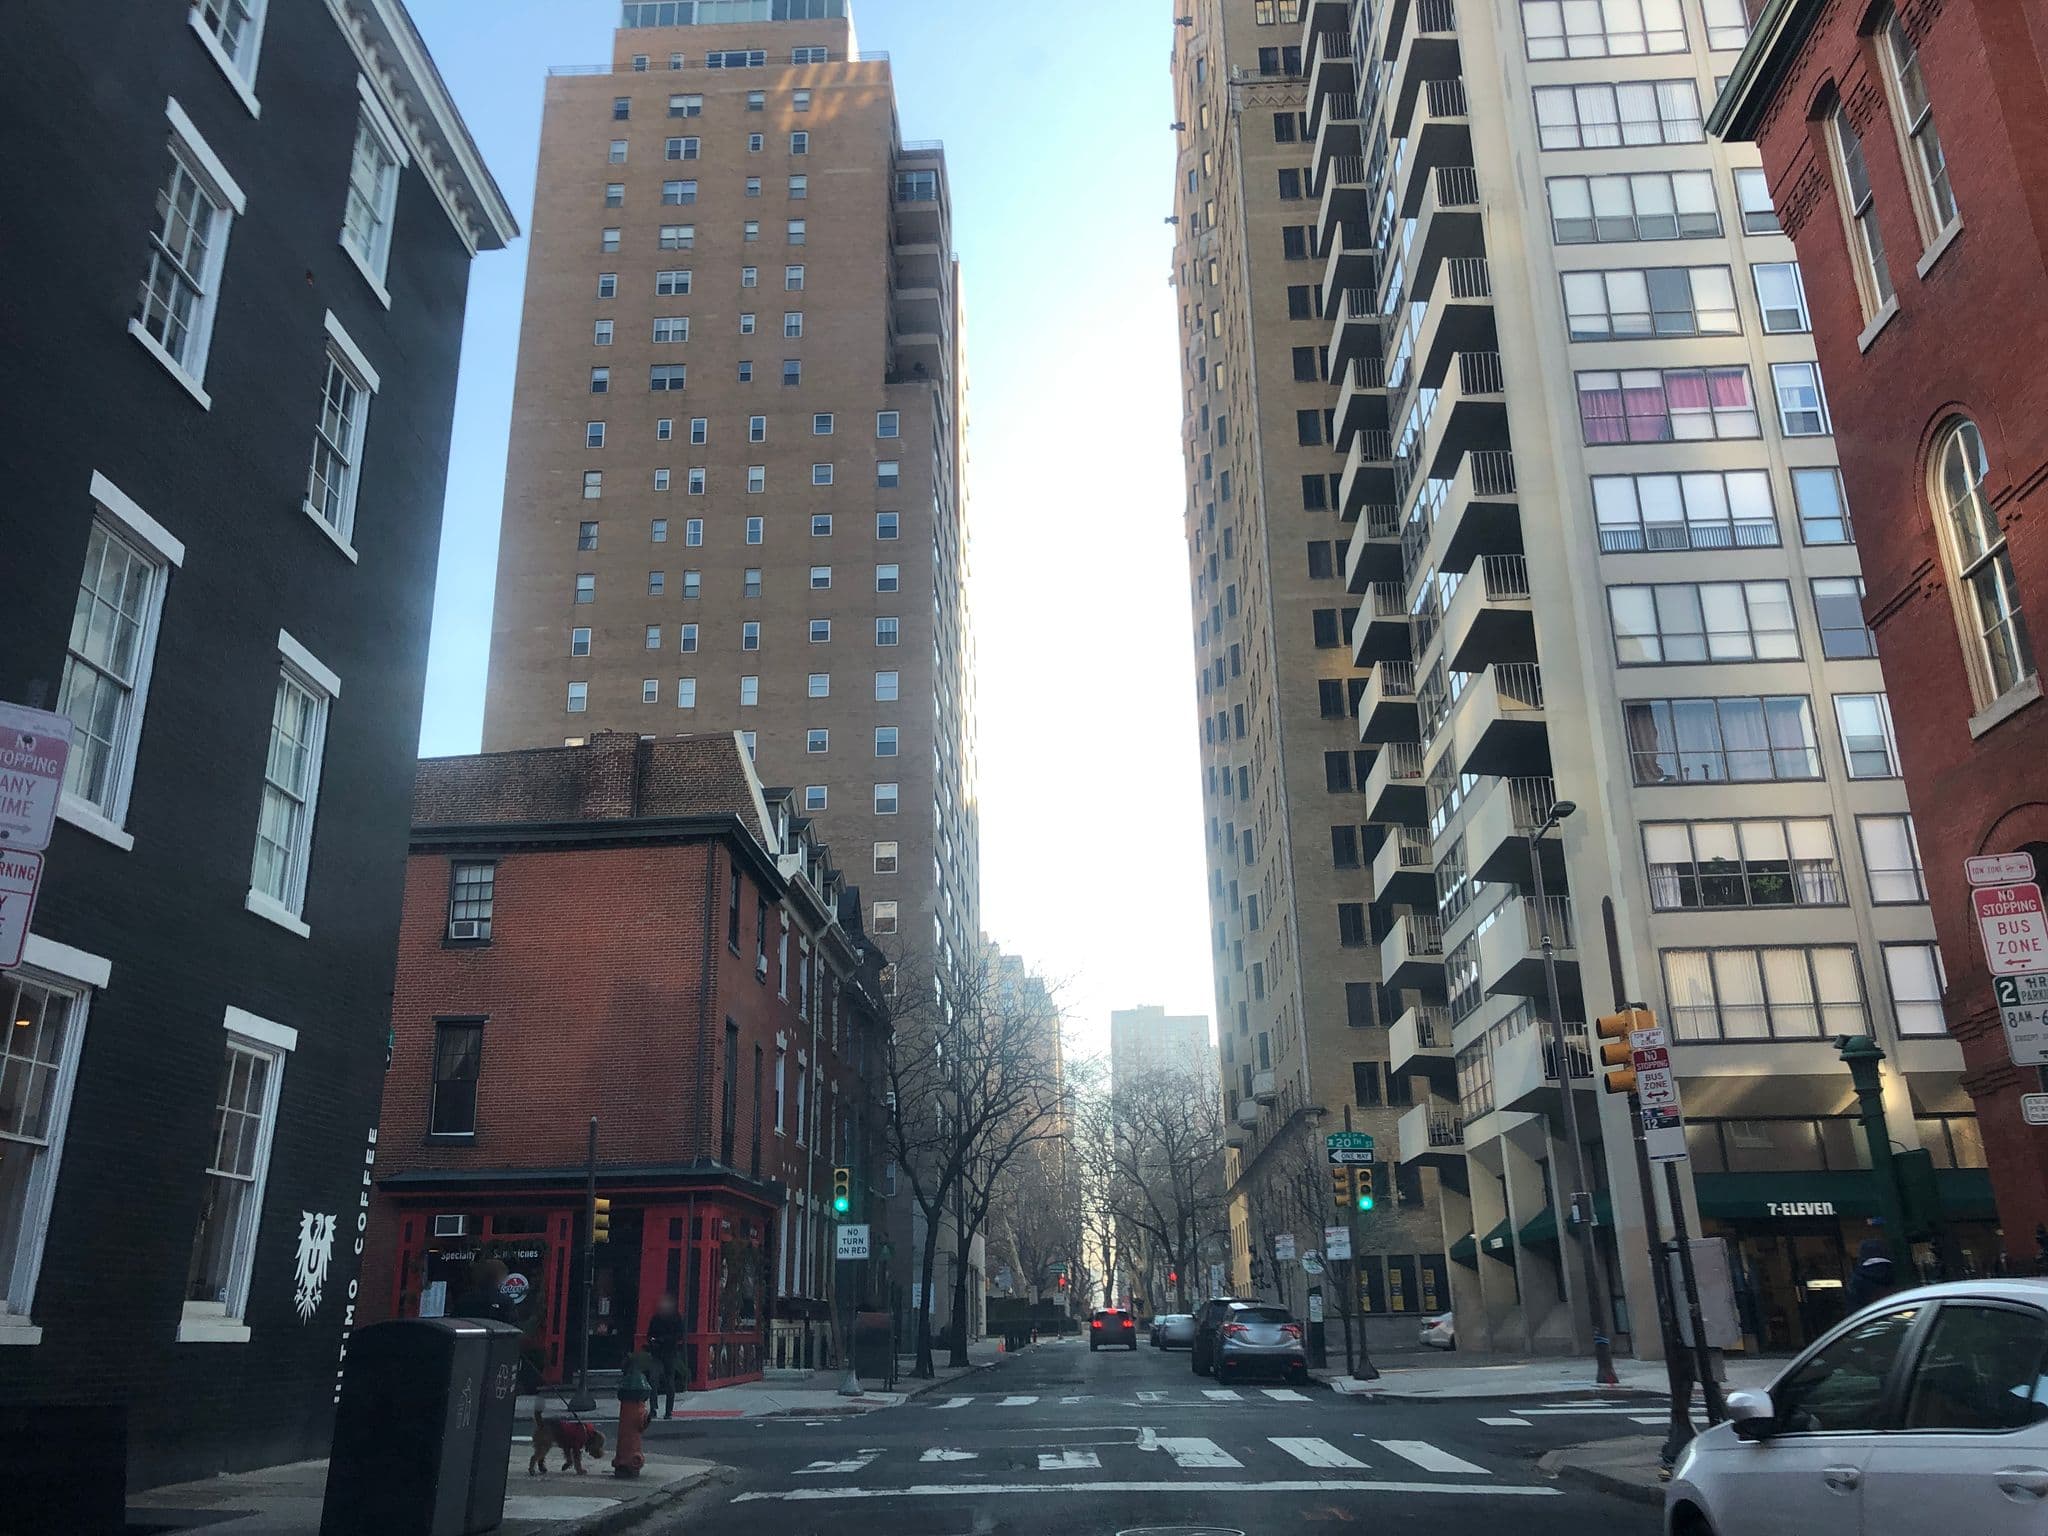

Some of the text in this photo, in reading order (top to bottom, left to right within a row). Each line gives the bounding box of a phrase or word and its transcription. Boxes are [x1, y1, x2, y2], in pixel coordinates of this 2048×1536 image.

[0, 749, 58, 775] OPPING
[0, 774, 36, 796] ANY
[0, 796, 34, 817] IME
[1997, 889, 2015, 902] NO
[1982, 899, 2037, 916] STOPPING
[1997, 919, 2031, 936] BUS
[1996, 937, 2042, 955] ZONE
[2000, 981, 2017, 1003] 2
[2021, 988, 2048, 1002] PARKI
[1644, 1050, 1658, 1061] NO
[1637, 1061, 1669, 1071] STOPPING
[1645, 1072, 1664, 1081] BUS
[1644, 1080, 1668, 1090] ZONE
[1645, 1118, 1659, 1129] 12
[355, 1127, 377, 1255] COFFEE
[847, 1228, 859, 1236] NO
[851, 1247, 867, 1255] RED
